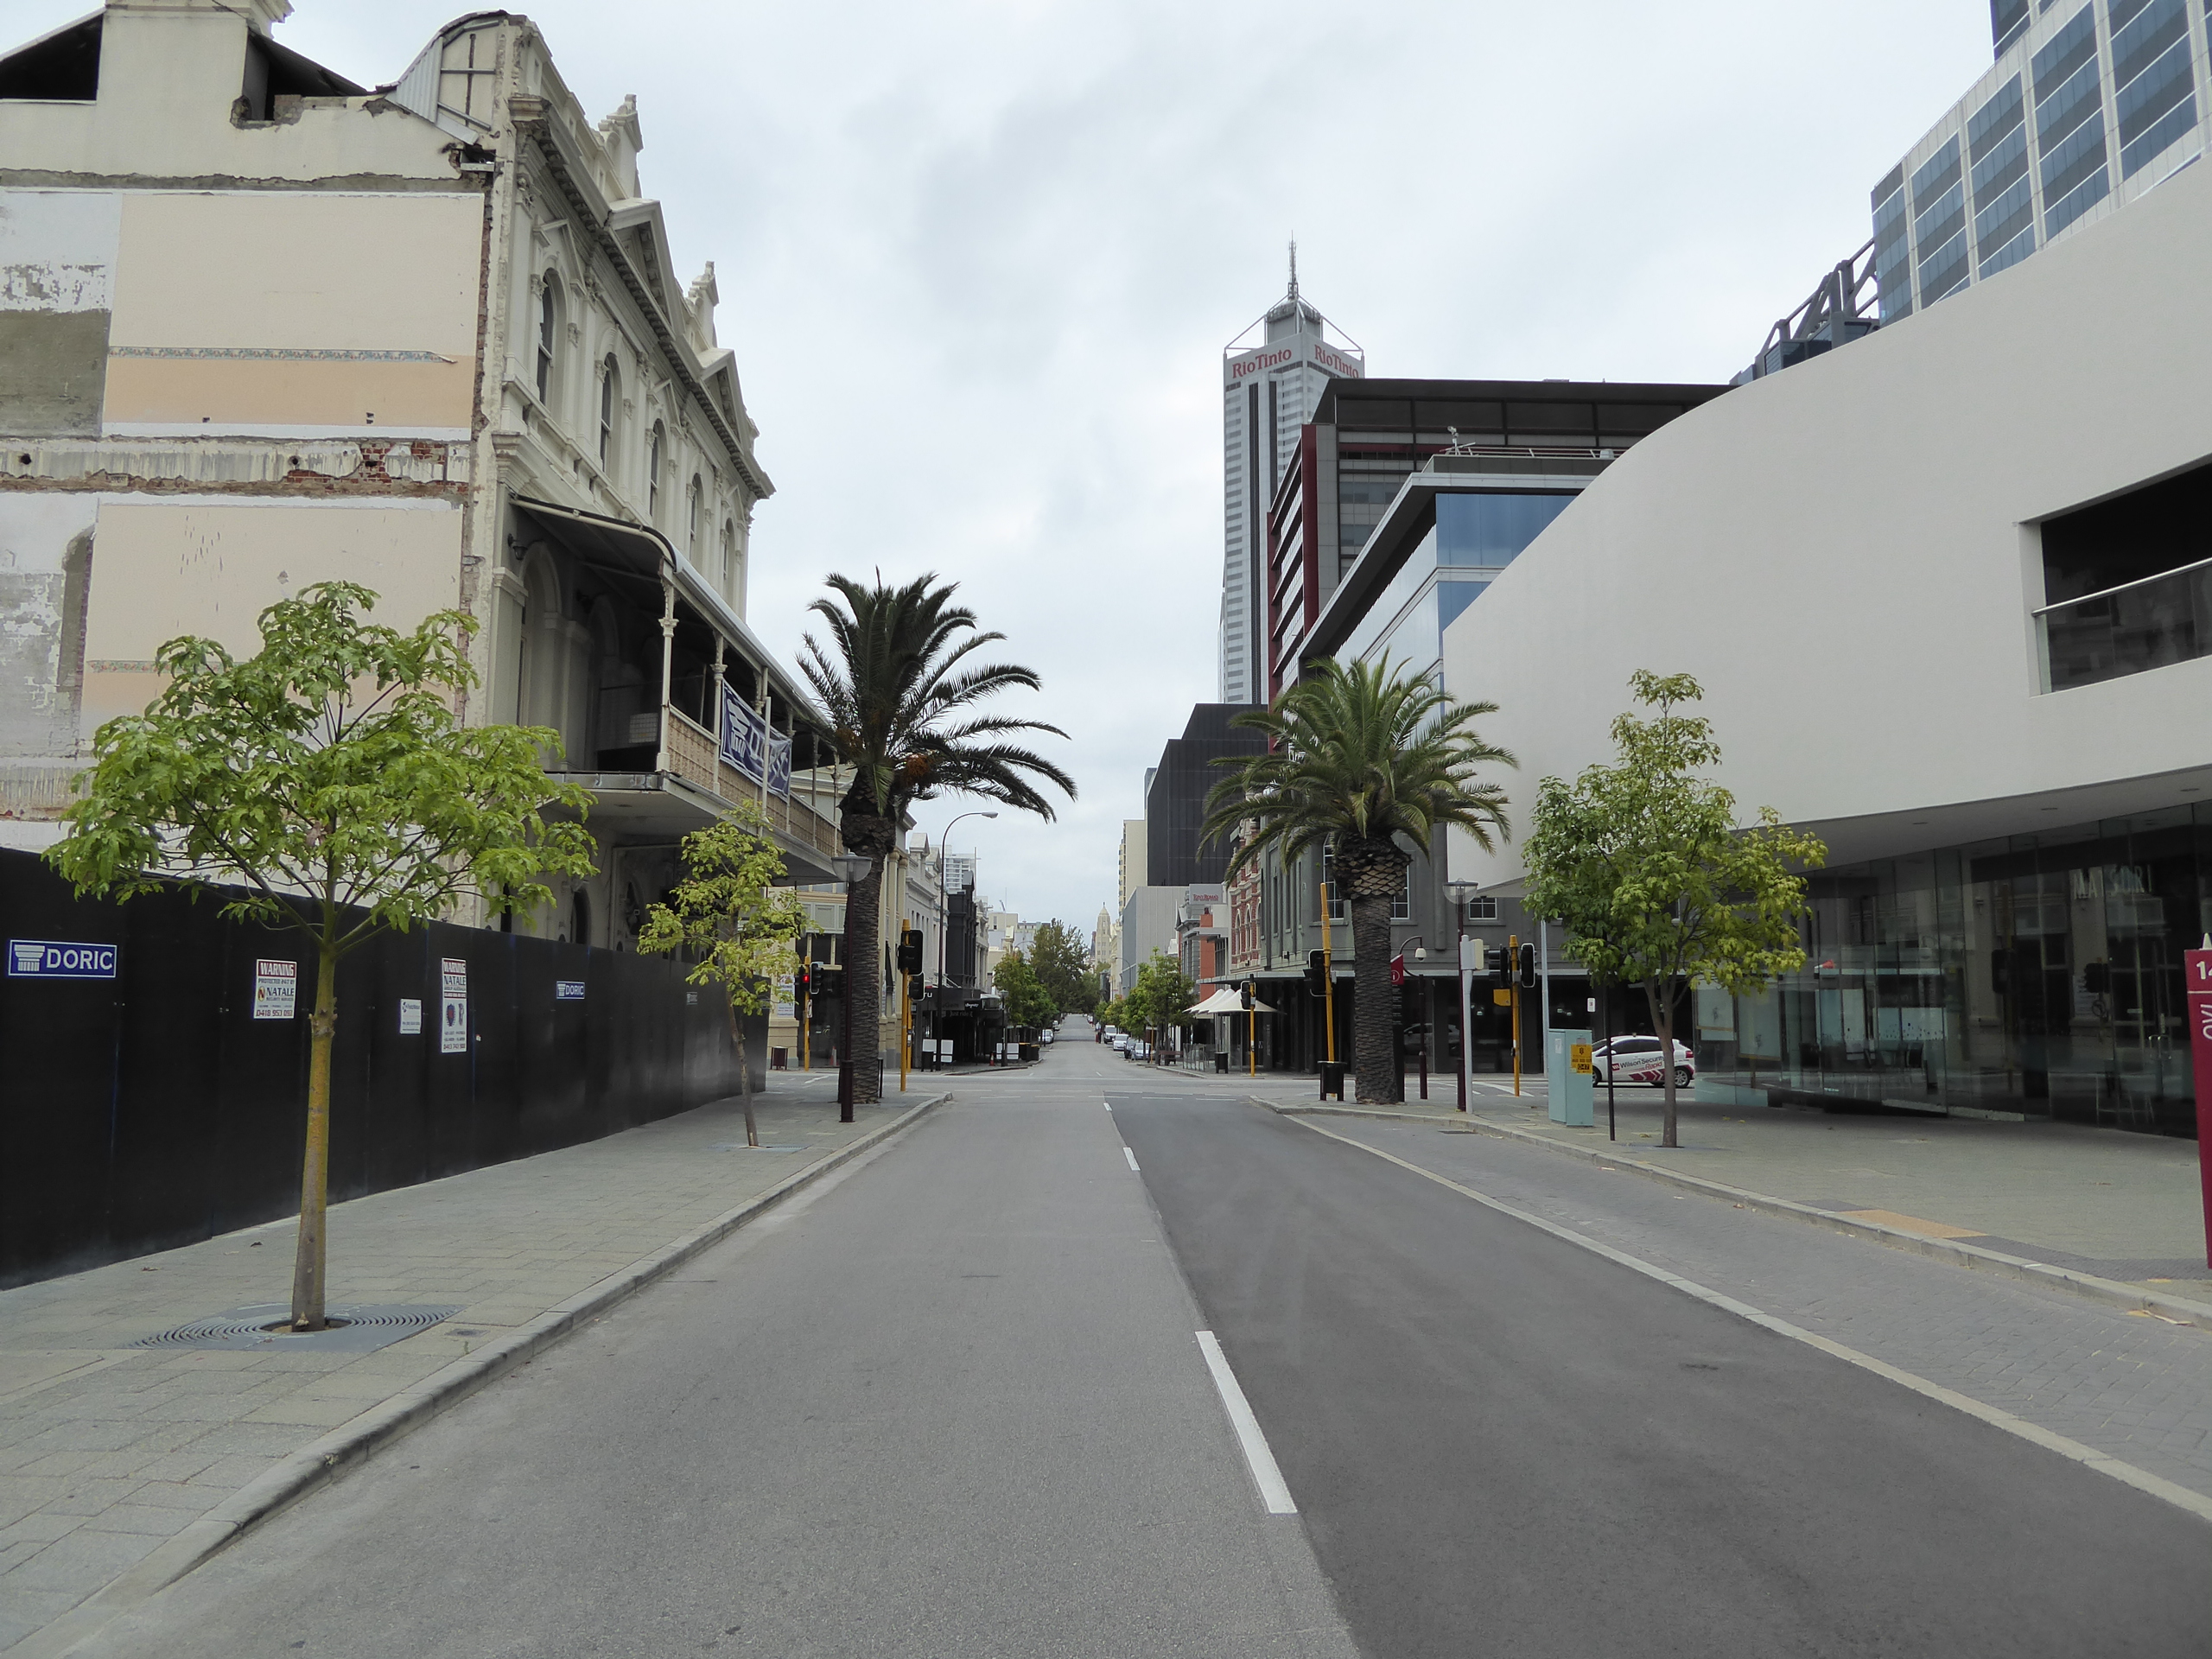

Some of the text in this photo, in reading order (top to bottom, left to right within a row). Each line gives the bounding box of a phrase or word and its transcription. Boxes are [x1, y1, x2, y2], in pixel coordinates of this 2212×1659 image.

[46, 948, 113, 971] DORIC
[260, 962, 294, 976] WARNING
[443, 962, 466, 973] WARNING
[443, 975, 466, 986] NATALE
[266, 987, 295, 997] NATALE
[565, 984, 584, 995] DORIC
[1620, 1060, 1641, 1069] Wilson
[1641, 1055, 1665, 1065] Security
[1644, 1061, 1662, 1070] Rapid
